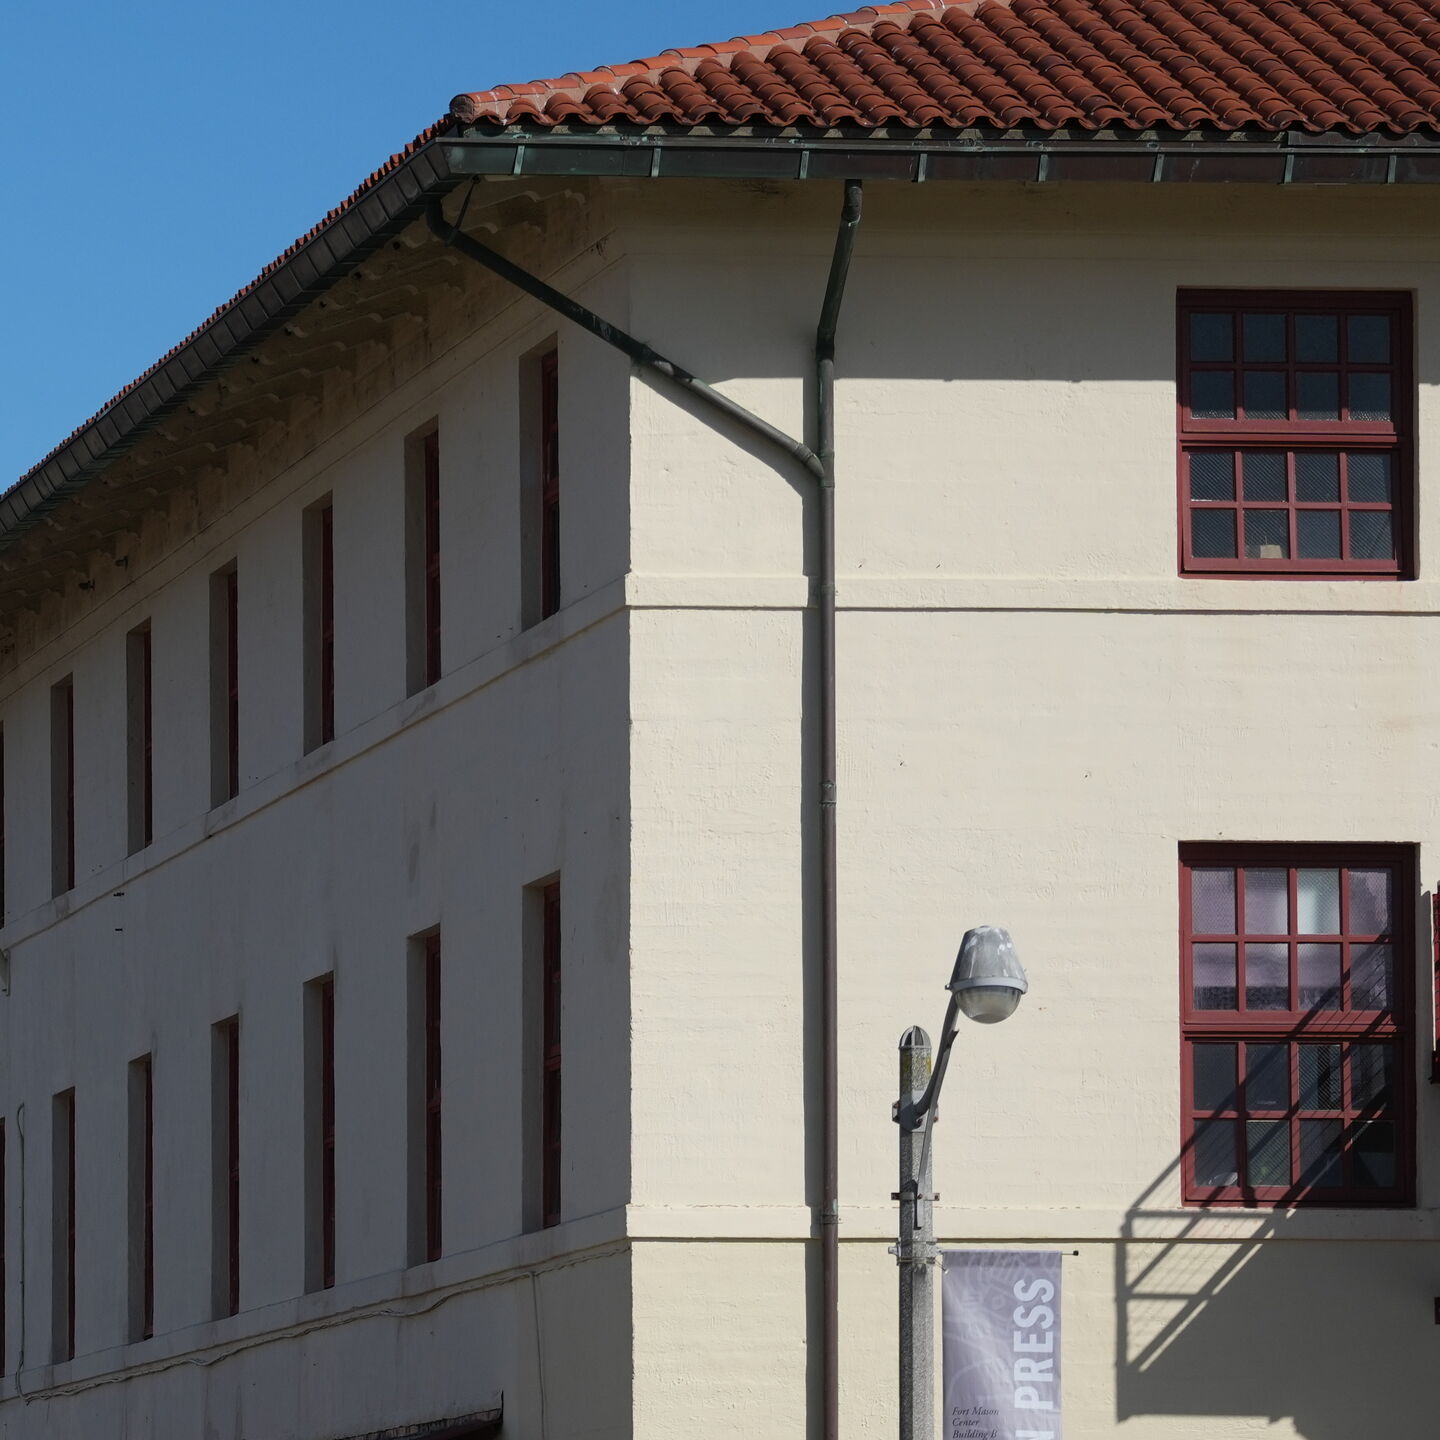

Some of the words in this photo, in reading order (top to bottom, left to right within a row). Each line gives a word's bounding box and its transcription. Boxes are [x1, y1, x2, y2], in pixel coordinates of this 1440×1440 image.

[1013, 1278, 1055, 1410] PRESS
[952, 1406, 969, 1415] Fort
[952, 1429, 988, 1440] Building
